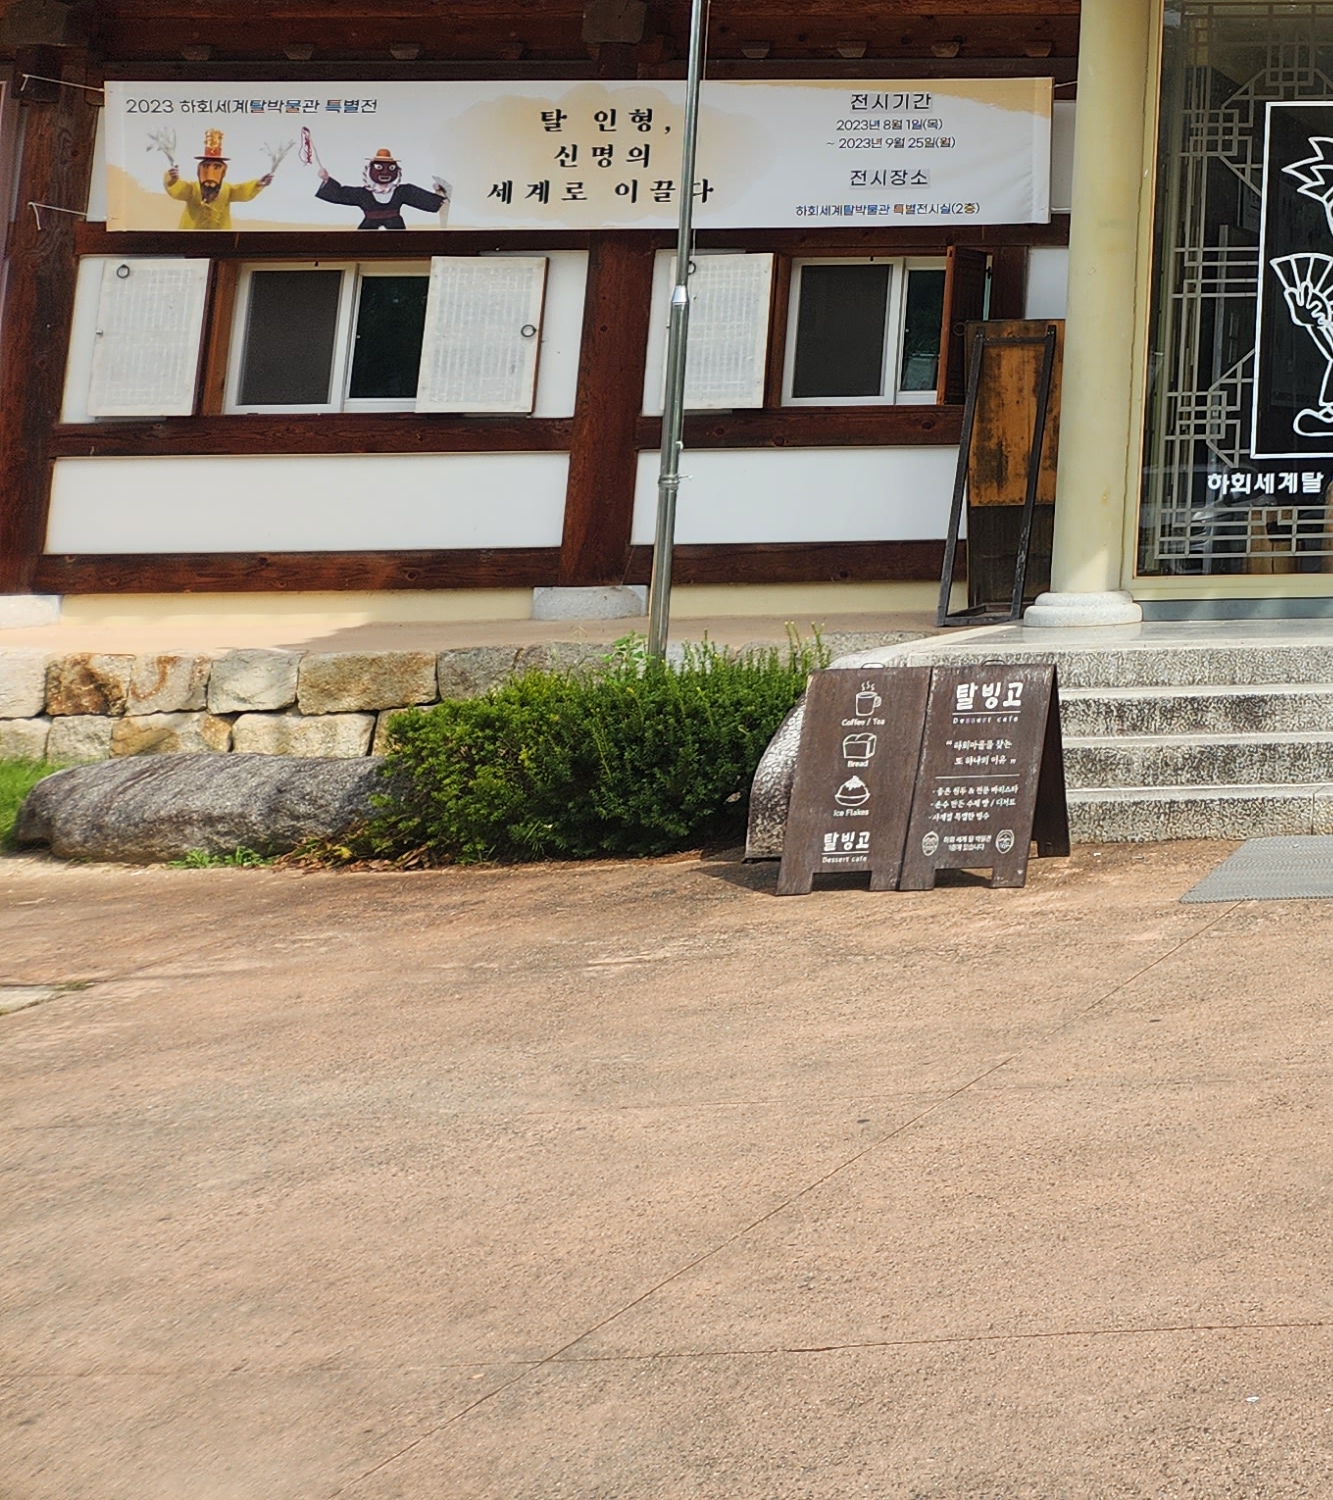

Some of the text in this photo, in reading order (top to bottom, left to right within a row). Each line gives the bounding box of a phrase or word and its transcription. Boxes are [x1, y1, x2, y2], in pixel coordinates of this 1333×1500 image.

[126, 98, 378, 114] 2023 하회세계탈박물관 특별전
[850, 93, 932, 111] 전시기간
[540, 108, 672, 135] 탈 인형,
[836, 119, 880, 131] 2023년
[883, 119, 903, 131] 8월
[839, 137, 883, 149] 2023년
[885, 137, 905, 149] 9월
[908, 136, 956, 149] 25일(월)
[554, 143, 651, 169] 신명의
[850, 169, 928, 187] 전시장소
[487, 179, 589, 205] 세계로
[796, 203, 890, 217] 하회세계탈박물관
[1207, 471, 1324, 495] 하회세계탈
[956, 682, 1023, 711] 탈빙고
[841, 718, 866, 726] Coffee
[872, 717, 885, 726] Tea
[847, 760, 869, 768] Bread
[833, 808, 869, 817] Ice Flakes
[824, 831, 871, 852] 탈빙고
[822, 855, 868, 864] Dessert cafe
